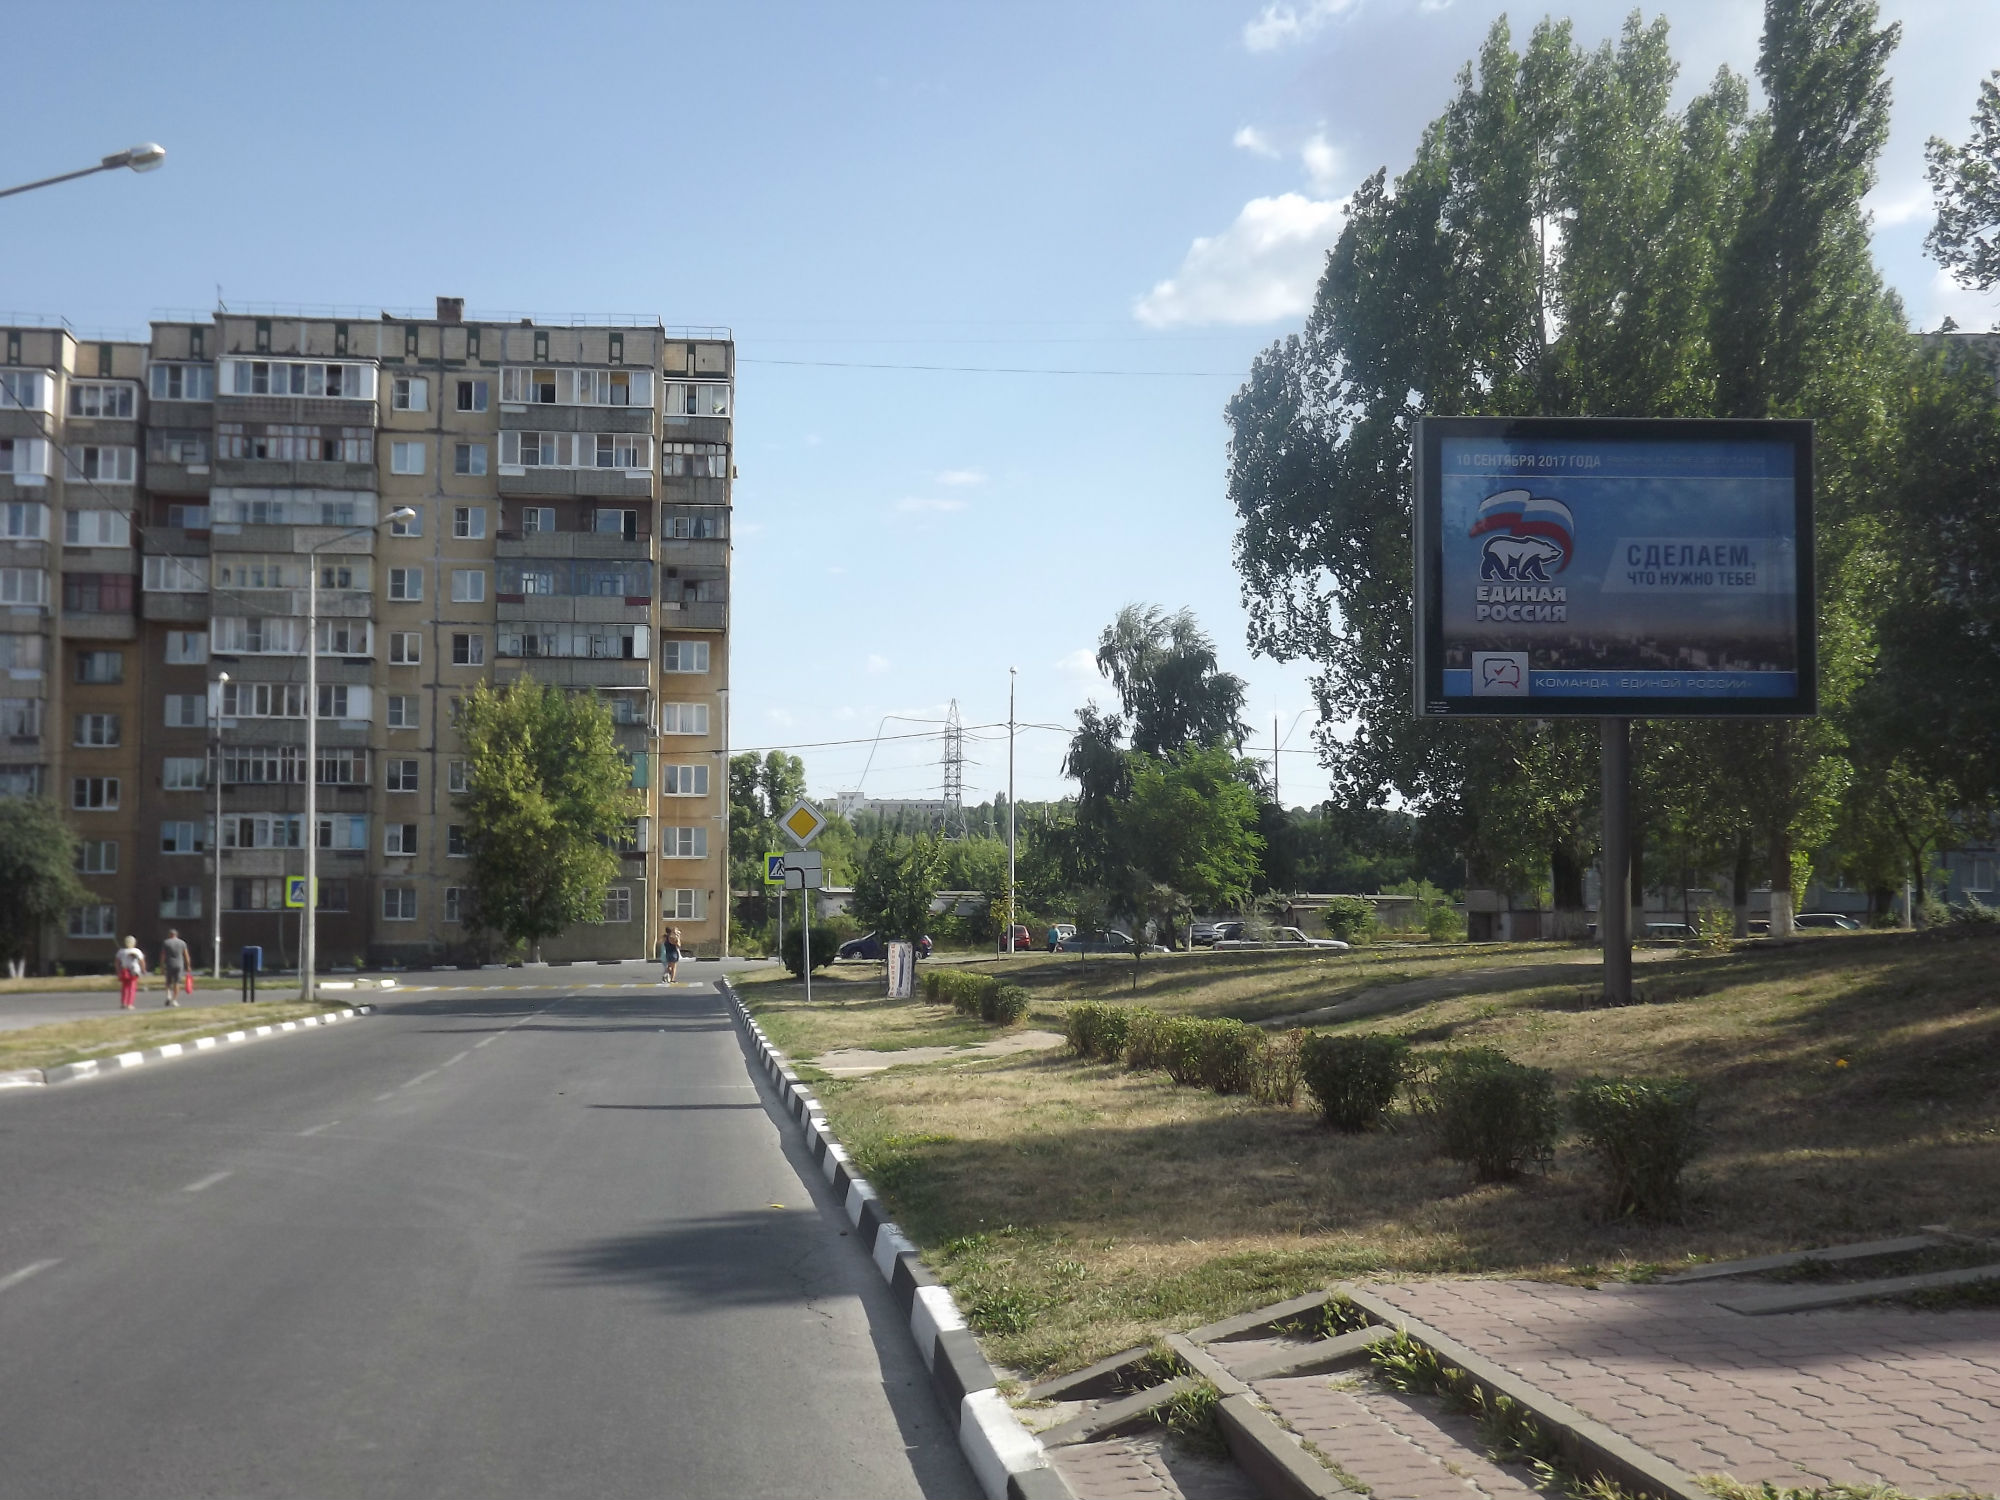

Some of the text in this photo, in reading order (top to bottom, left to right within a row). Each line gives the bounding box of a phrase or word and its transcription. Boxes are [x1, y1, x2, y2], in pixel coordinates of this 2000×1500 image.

[1456, 454, 1470, 466] 10
[1473, 454, 1535, 467] СЕНТЯБРЯ
[1538, 455, 1566, 467] 2017
[1569, 455, 1601, 469] ГОДА
[1627, 544, 1756, 570] СДЕЛАЕМ,
[1627, 571, 1756, 586] ЧТО НУЖНО ТЕБЕ!
[1476, 585, 1567, 603] ЕДИНАЯ
[1476, 604, 1567, 622] РОССИЯ
[1535, 678, 1609, 689] КОМАНДА
